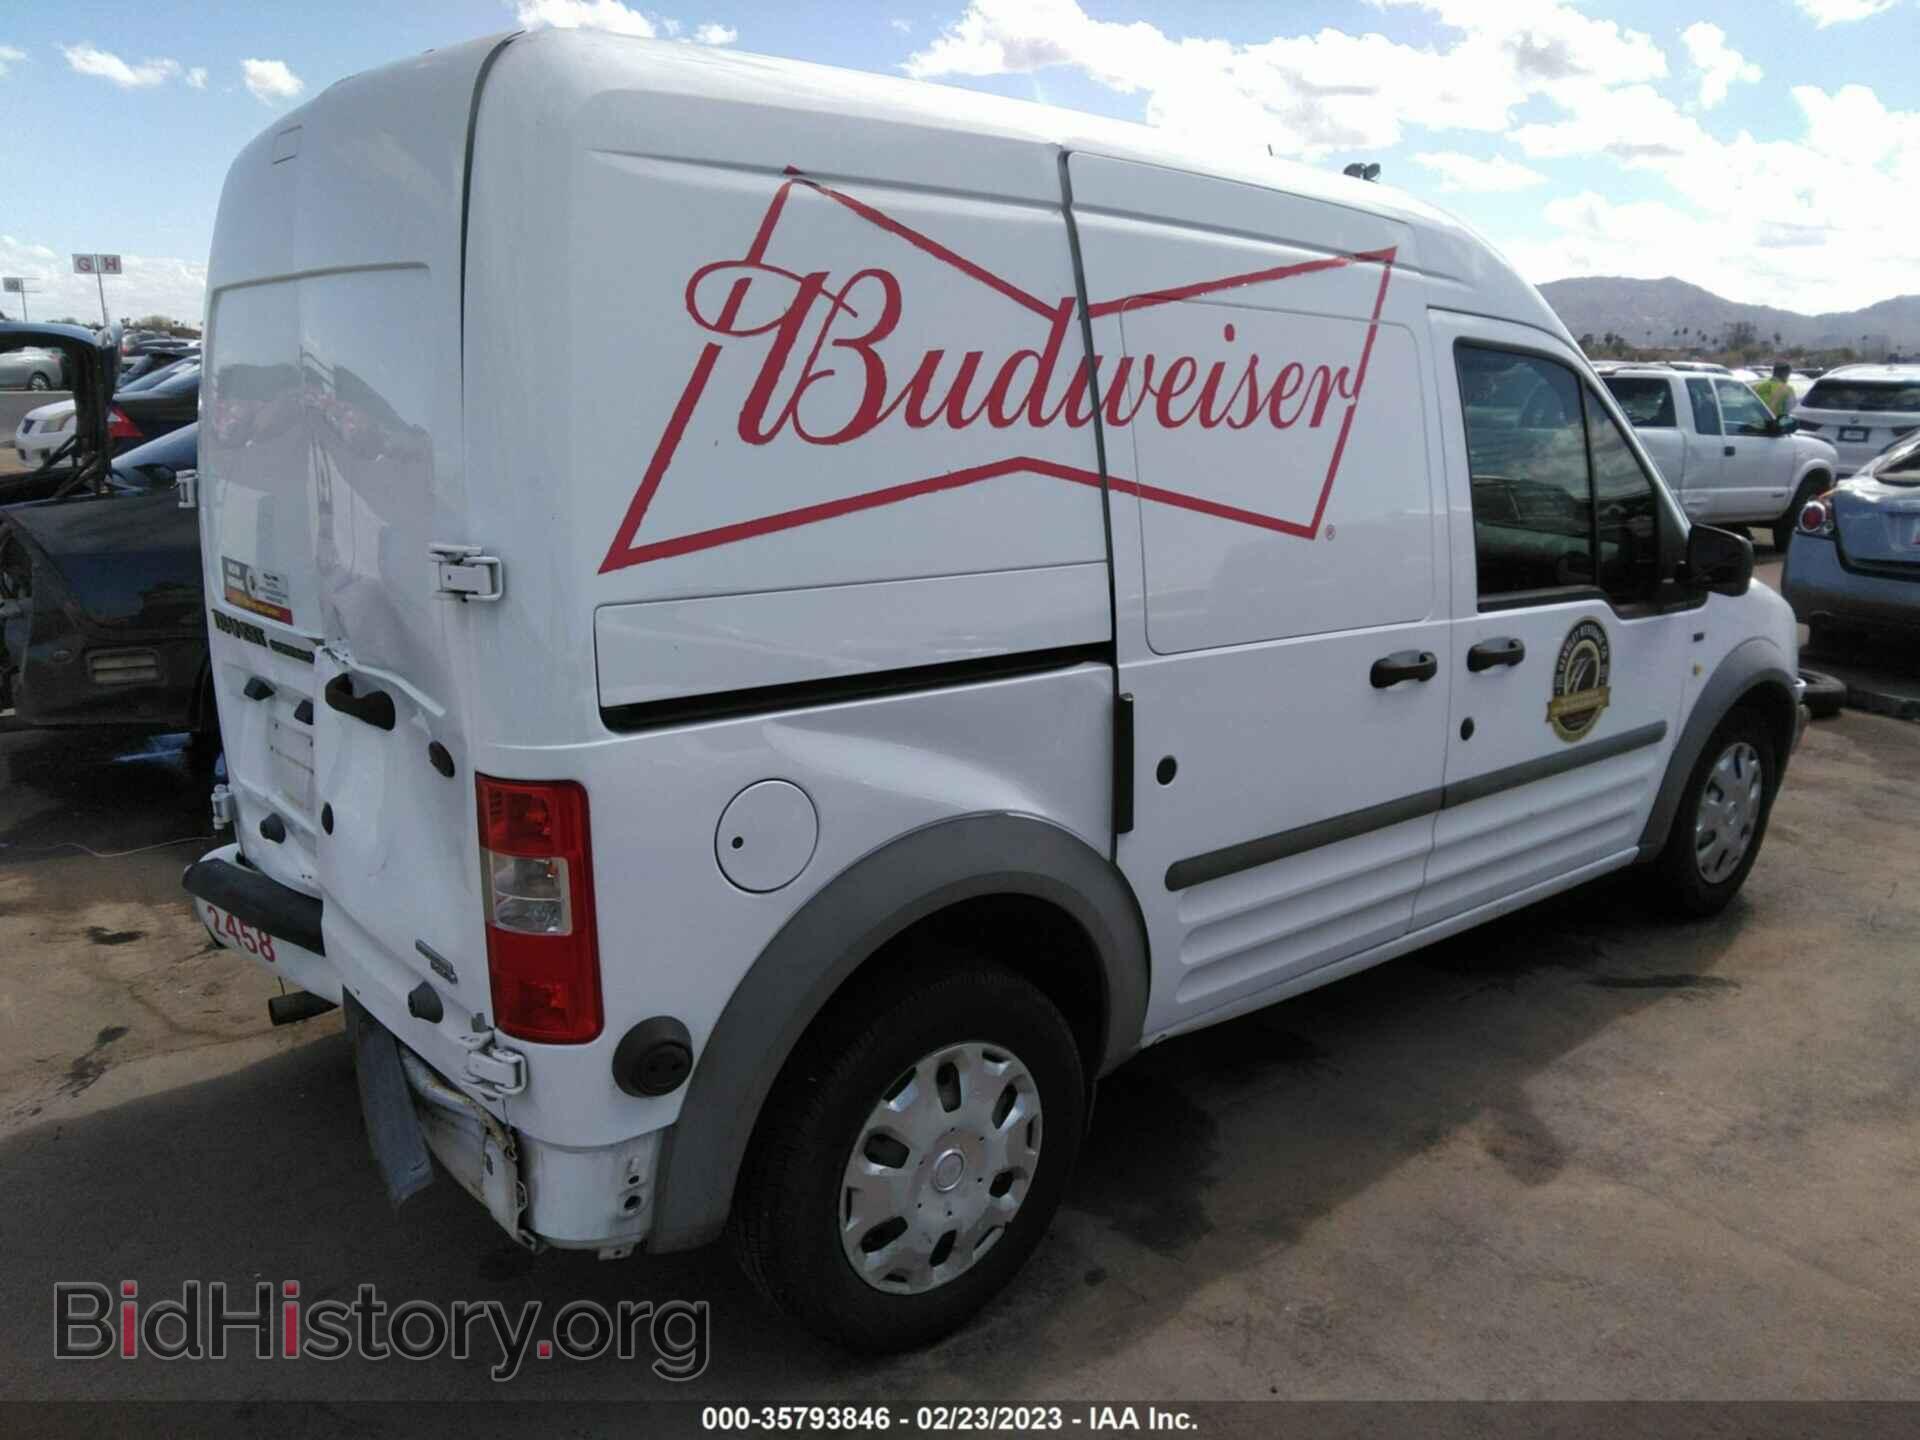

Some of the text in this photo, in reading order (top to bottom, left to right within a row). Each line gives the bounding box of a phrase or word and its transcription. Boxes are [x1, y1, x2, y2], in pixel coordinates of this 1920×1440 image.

[77, 257, 117, 272] G H
[686, 260, 1358, 446] Budweiser
[207, 904, 275, 962] 2458
